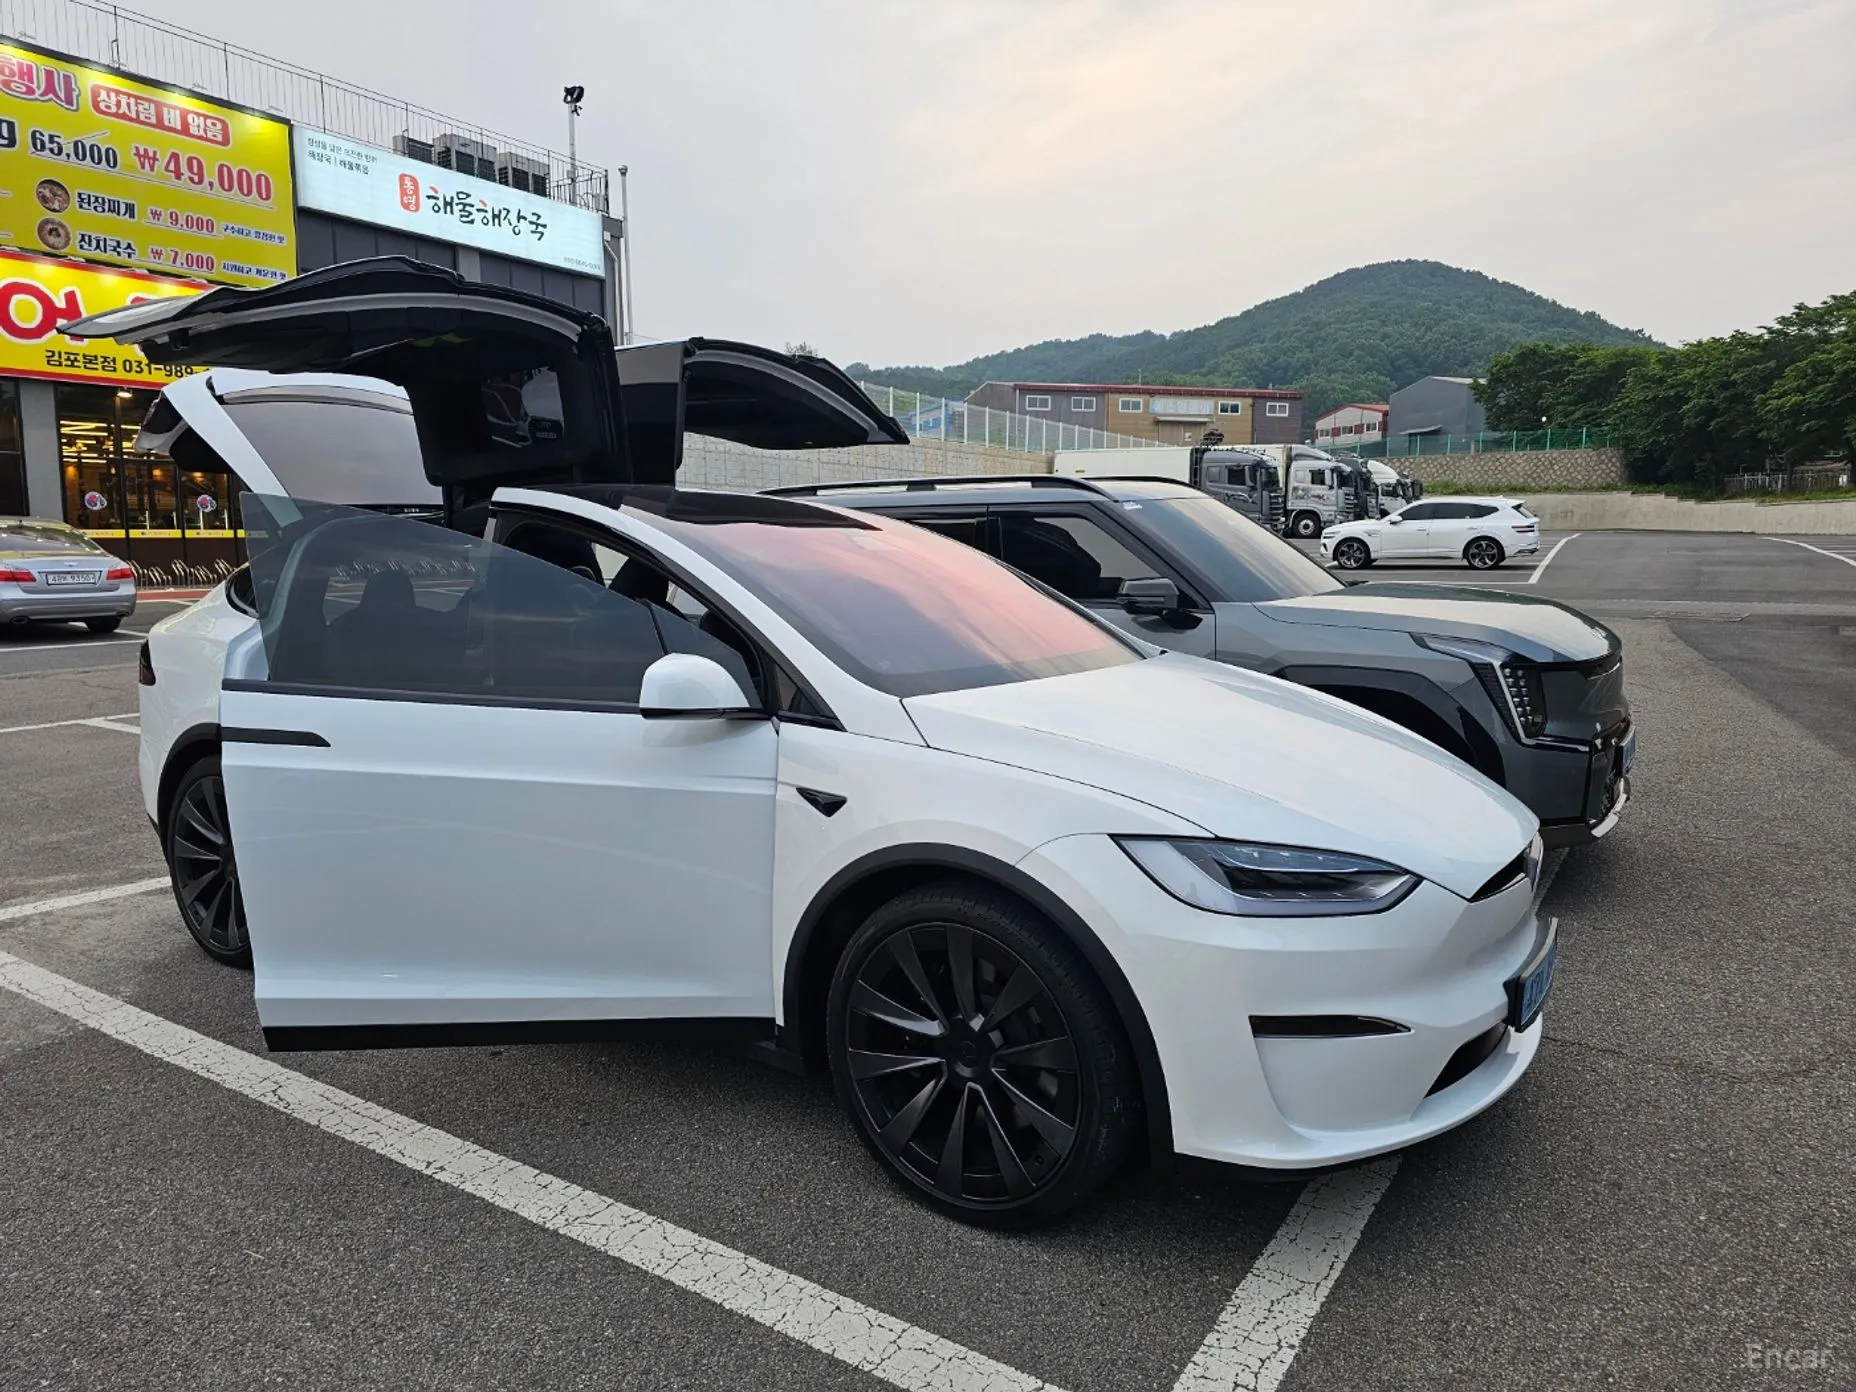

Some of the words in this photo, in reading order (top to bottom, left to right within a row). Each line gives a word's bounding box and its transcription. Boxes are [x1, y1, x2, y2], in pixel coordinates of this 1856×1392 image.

[0, 55, 77, 109] 행사
[97, 88, 157, 125] 상차림
[162, 106, 182, 131] 비
[186, 112, 224, 142] 없음
[30, 129, 118, 170] 65,000
[76, 191, 136, 220] 된장찌개
[425, 185, 548, 241] 해물해장국
[78, 232, 137, 259] 잔치국수
[45, 349, 117, 373] 김포본점
